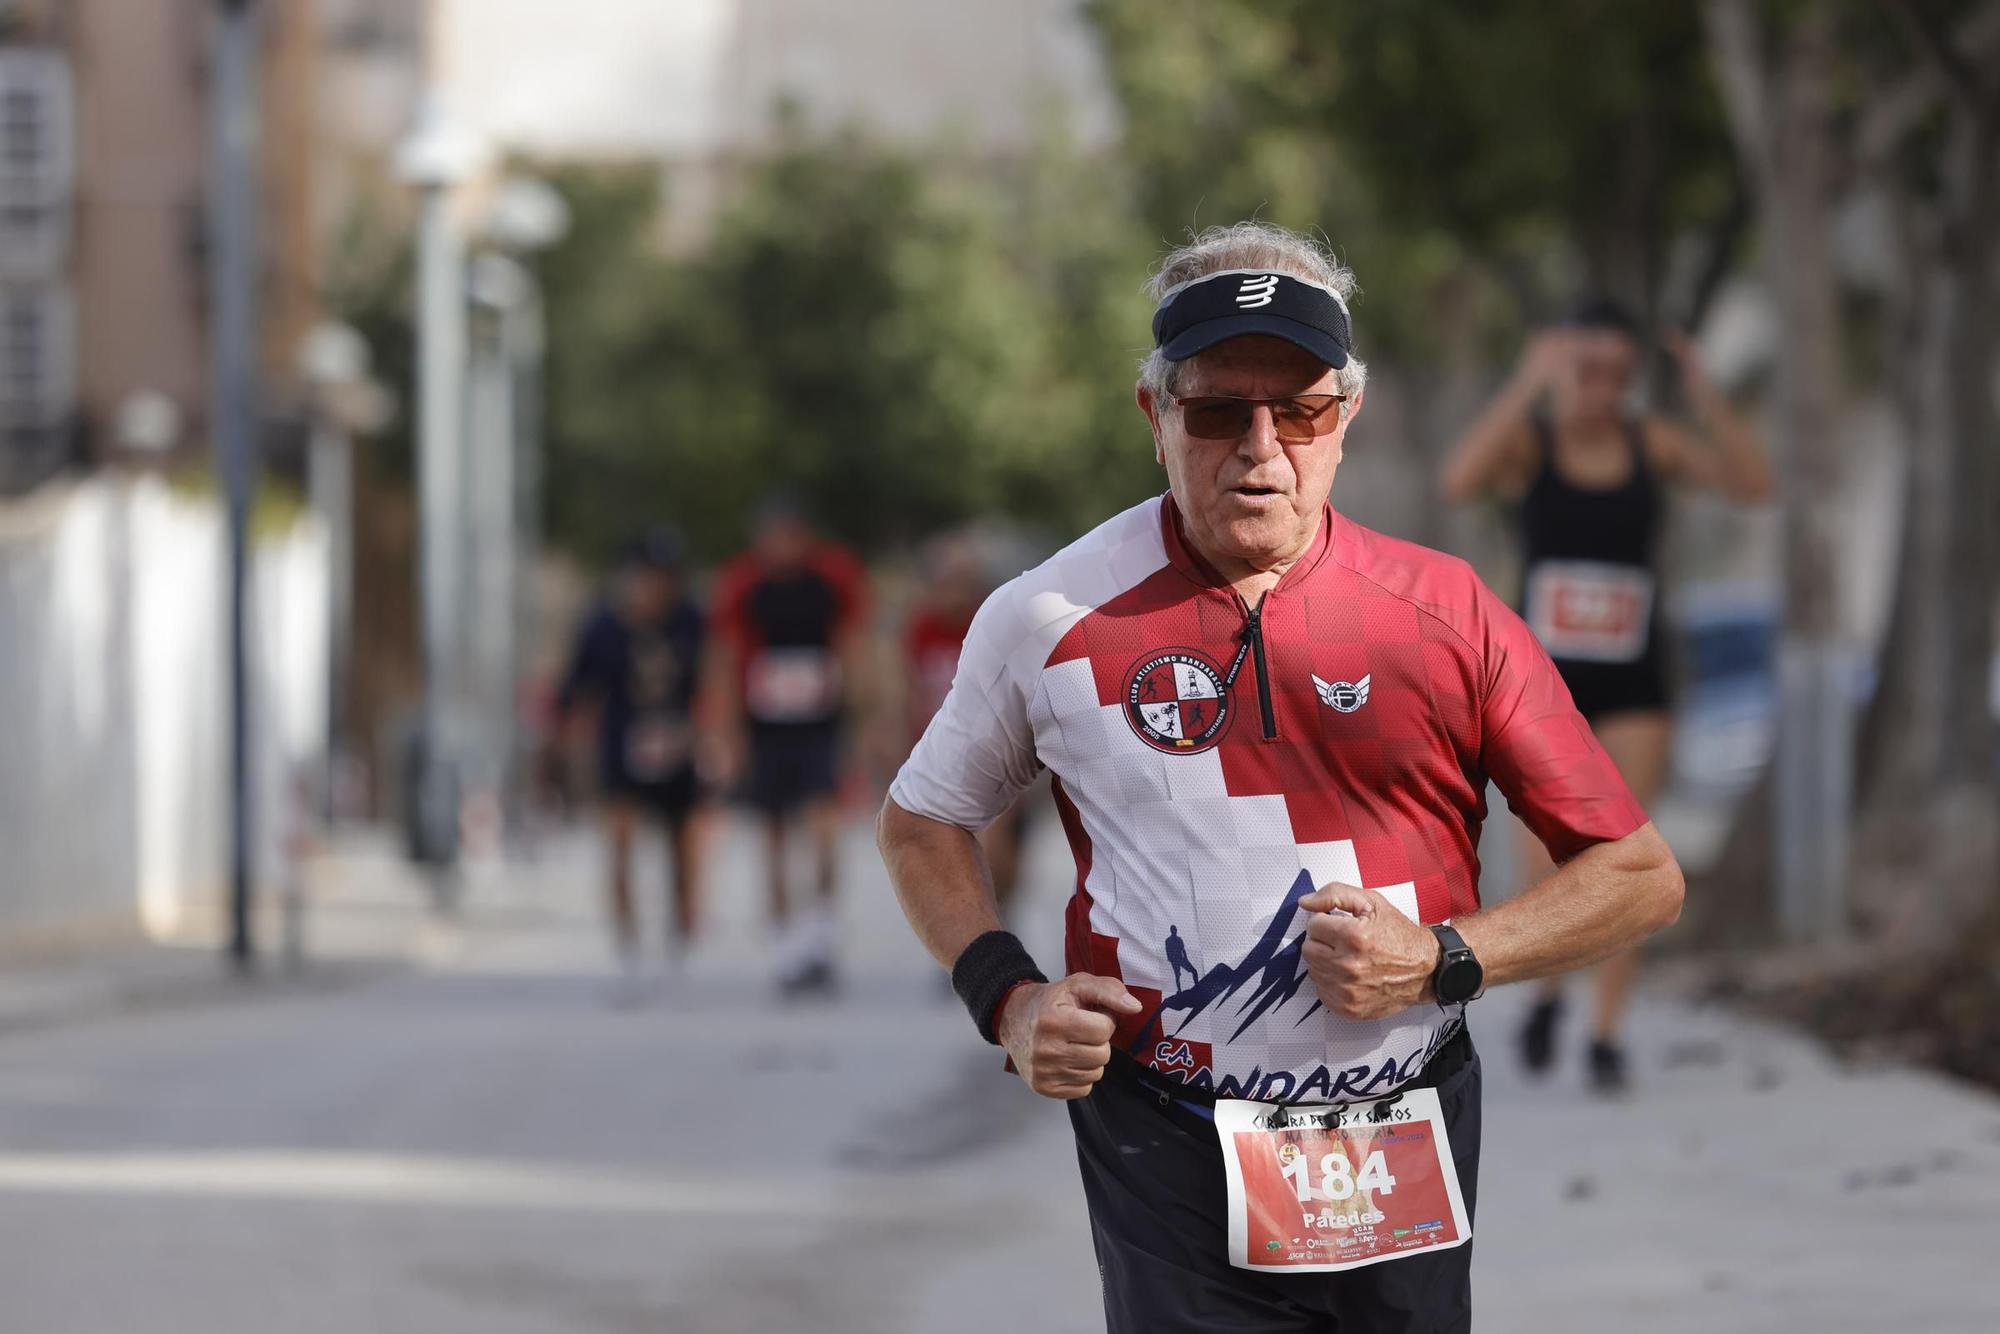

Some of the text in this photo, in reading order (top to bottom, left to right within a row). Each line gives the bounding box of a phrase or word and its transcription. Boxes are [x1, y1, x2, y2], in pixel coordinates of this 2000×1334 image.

[1130, 655, 1226, 704] CLUB ATLETISMO MANDARACHE
[1142, 724, 1161, 741] 2005
[1204, 708, 1226, 738] CARTAGENA
[1282, 1150, 1396, 1202] 184
